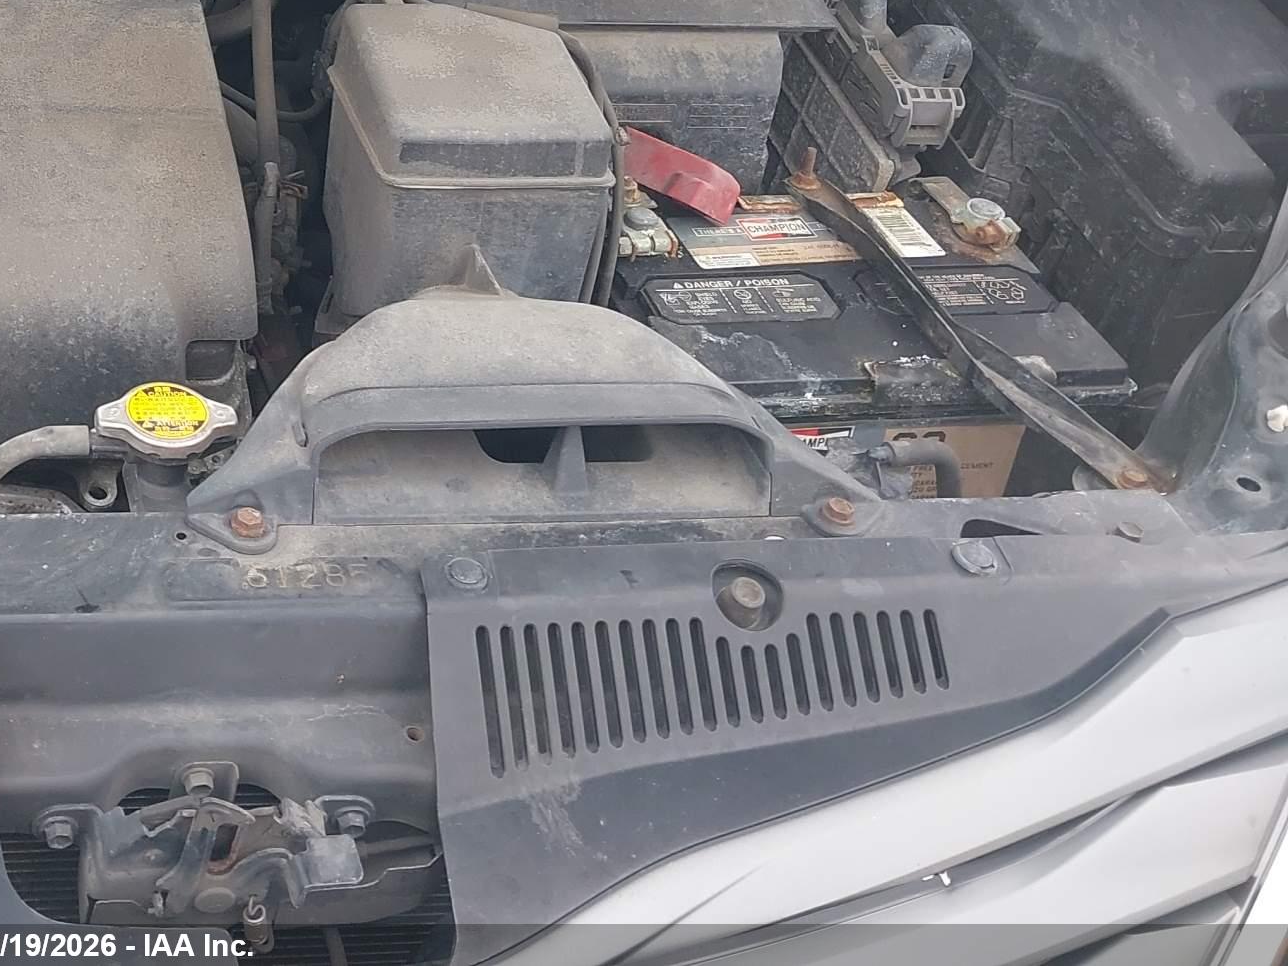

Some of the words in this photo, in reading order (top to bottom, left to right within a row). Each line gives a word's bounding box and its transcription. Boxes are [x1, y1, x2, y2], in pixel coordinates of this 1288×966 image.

[747, 222, 807, 233] CHAMPION
[683, 280, 734, 289] DANGER
[743, 278, 790, 287] POISON
